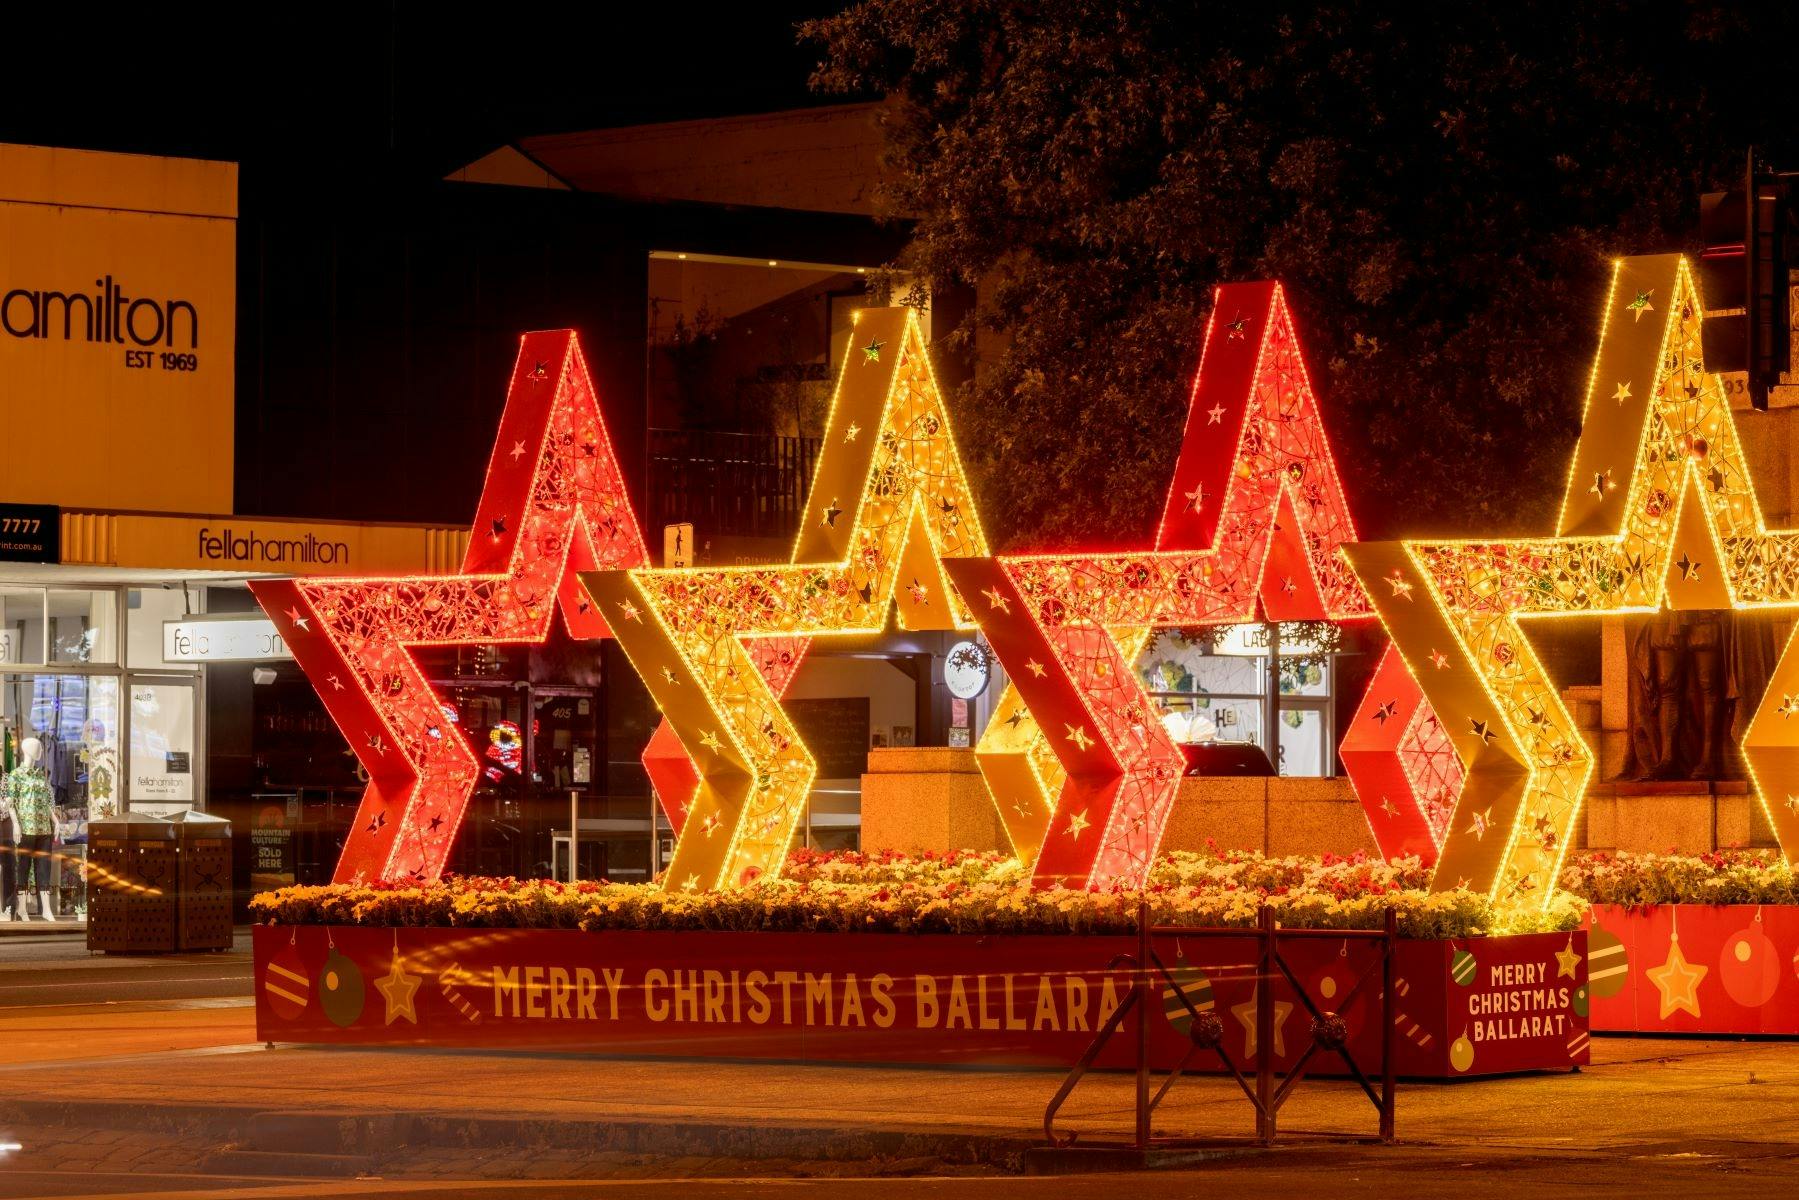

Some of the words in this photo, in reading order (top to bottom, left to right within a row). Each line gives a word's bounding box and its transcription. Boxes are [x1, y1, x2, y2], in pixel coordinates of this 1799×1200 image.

[1, 275, 198, 349] amilton
[125, 350, 154, 368] EST
[159, 352, 197, 371] 1969
[1724, 379, 1749, 395] 93
[2, 518, 41, 534] 7777
[199, 528, 349, 564] fellahamilton
[552, 707, 572, 719] 405
[251, 829, 291, 837] MOUNTAIN
[251, 837, 282, 845] CULTURE
[258, 849, 282, 858] SOLD
[258, 859, 282, 868] HERE
[1491, 962, 1546, 986] MERRY
[492, 965, 625, 1020] MERRY
[644, 968, 896, 1027] CHRISTMAS
[915, 973, 1154, 1032] BALLARA
[1468, 987, 1570, 1015] CHRISTMAS
[1473, 1014, 1566, 1042] BALLARAT
